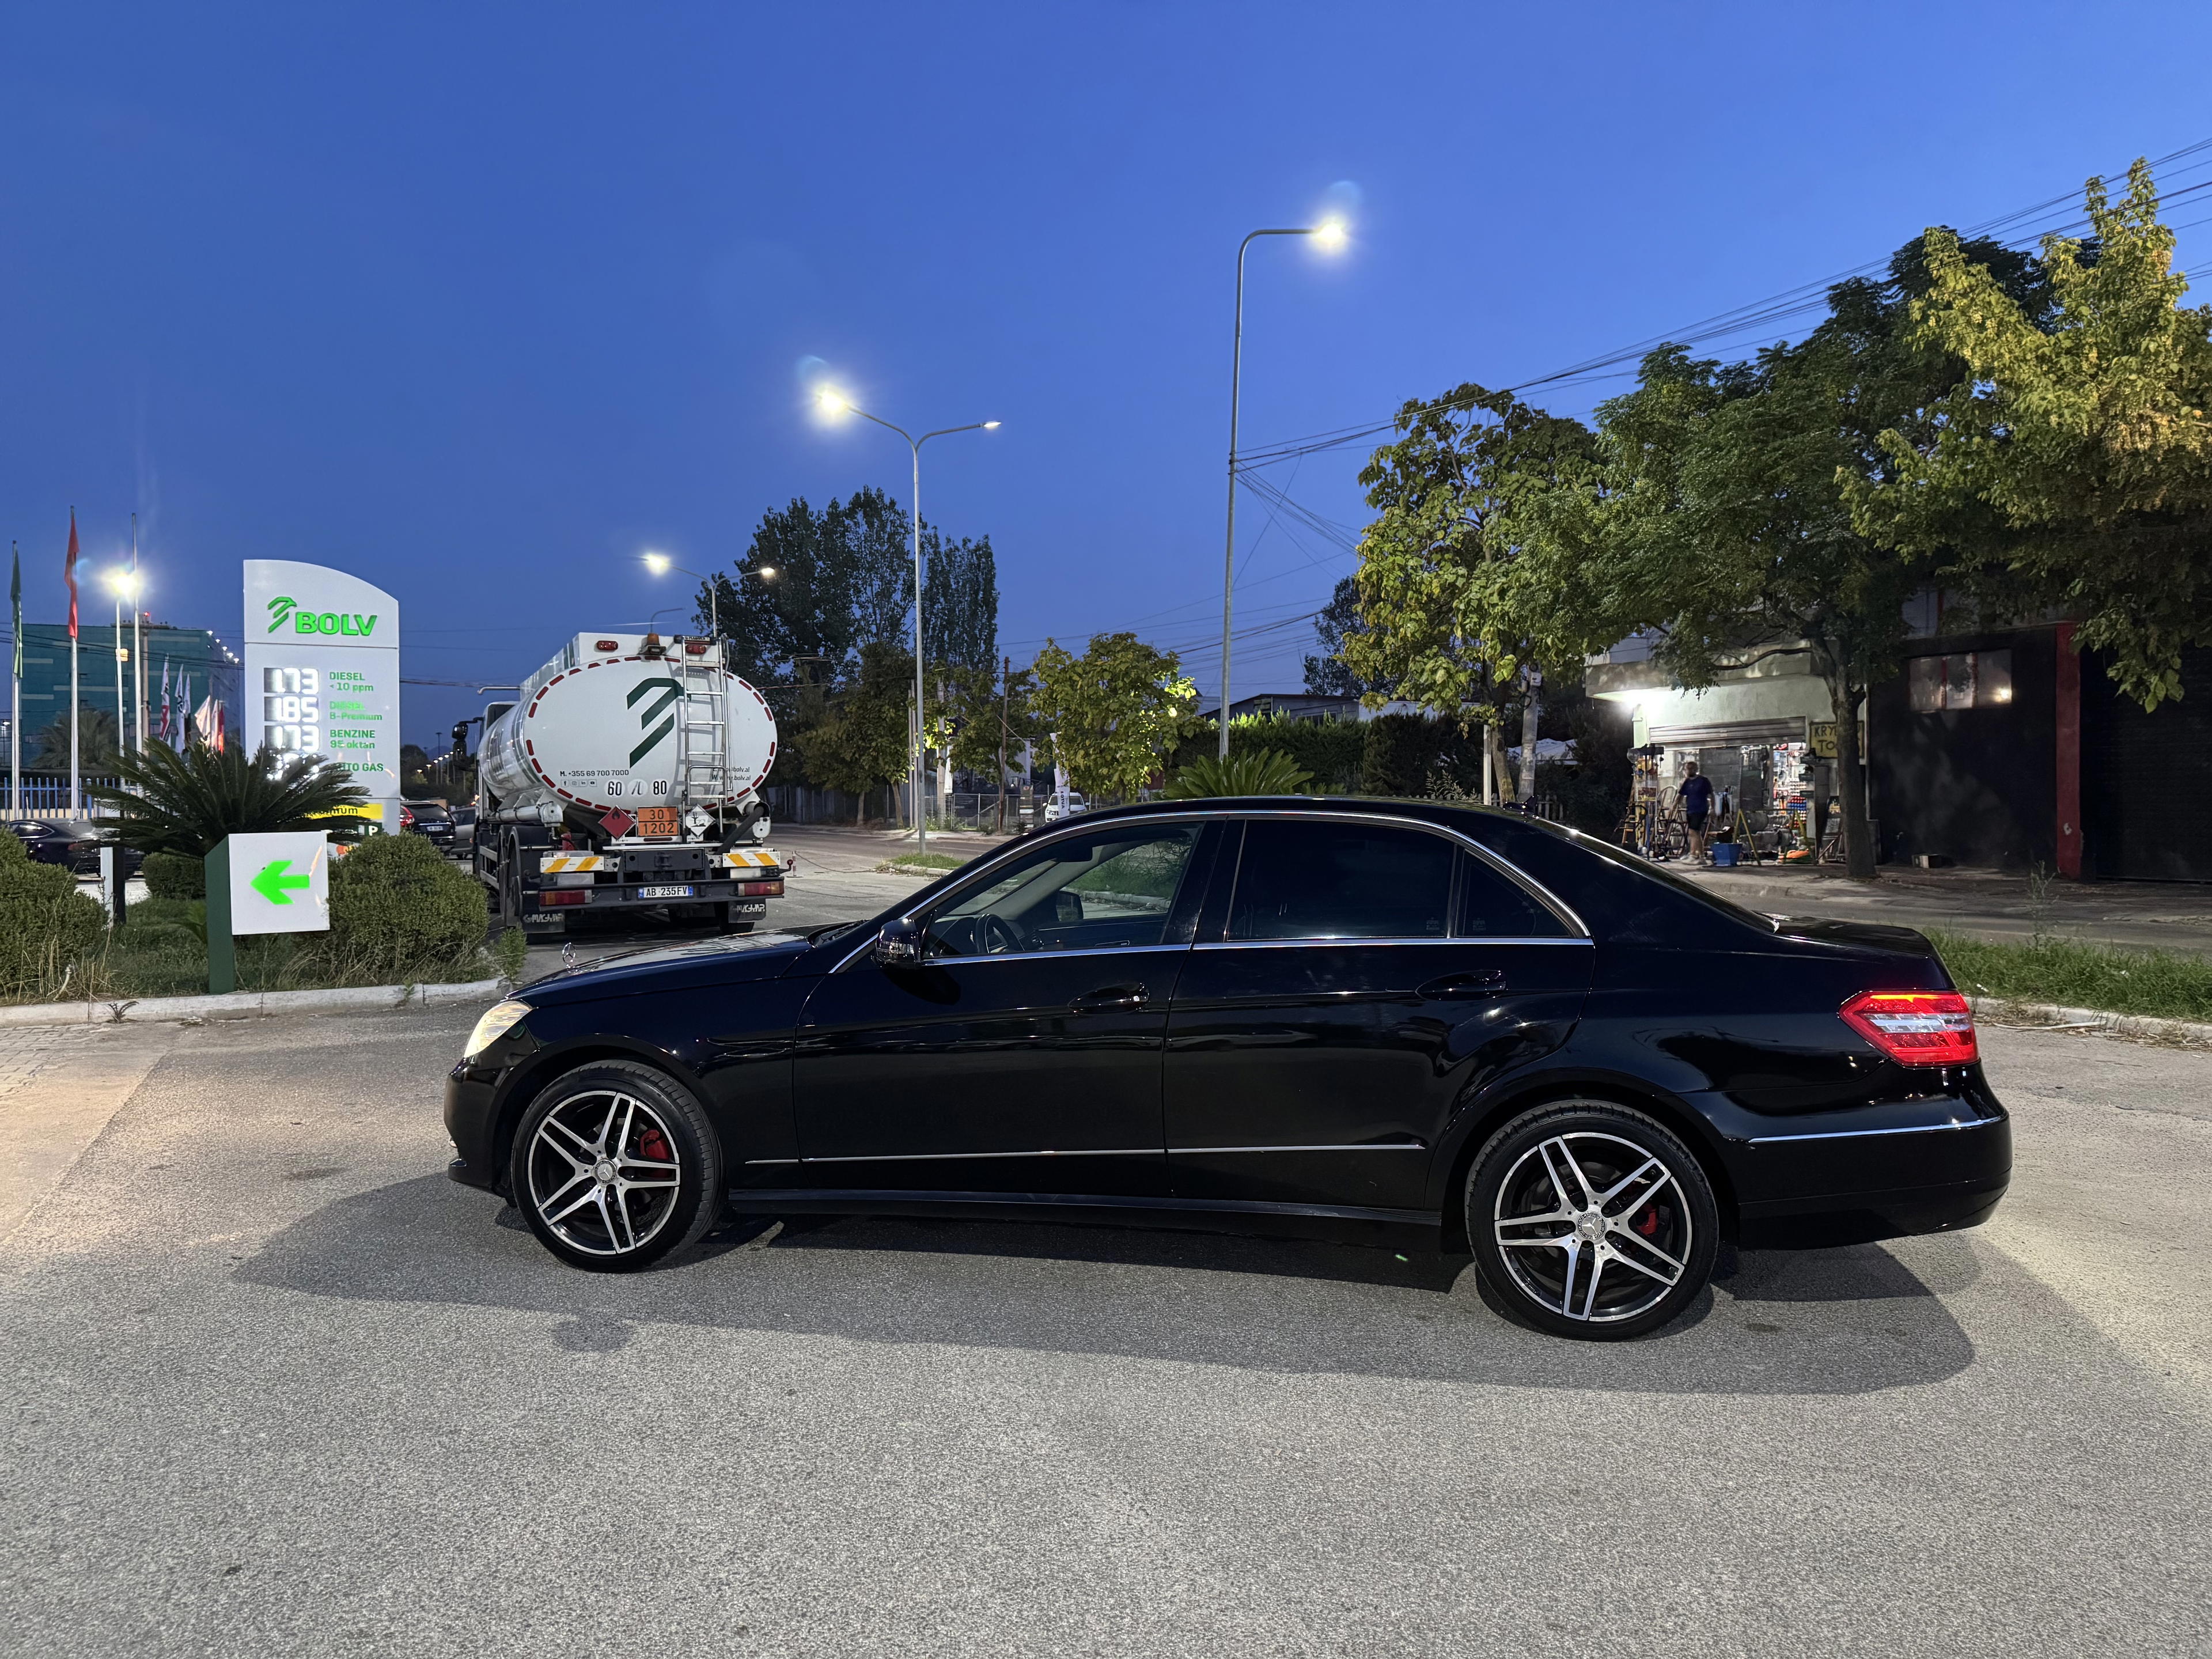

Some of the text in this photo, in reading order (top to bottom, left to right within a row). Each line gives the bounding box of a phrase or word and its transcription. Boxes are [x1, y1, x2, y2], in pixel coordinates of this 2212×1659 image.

[296, 611, 378, 636] BOLV
[329, 672, 366, 680] DIESEL
[337, 683, 350, 691] 10
[353, 685, 374, 693] ppm
[330, 729, 376, 738] BENZINE
[330, 740, 375, 749] 95 oktan
[362, 763, 384, 771] GAS
[608, 781, 622, 796] 60
[653, 781, 667, 795] 80
[650, 809, 664, 820] 30
[643, 822, 674, 834] 1202
[646, 888, 656, 896] AB
